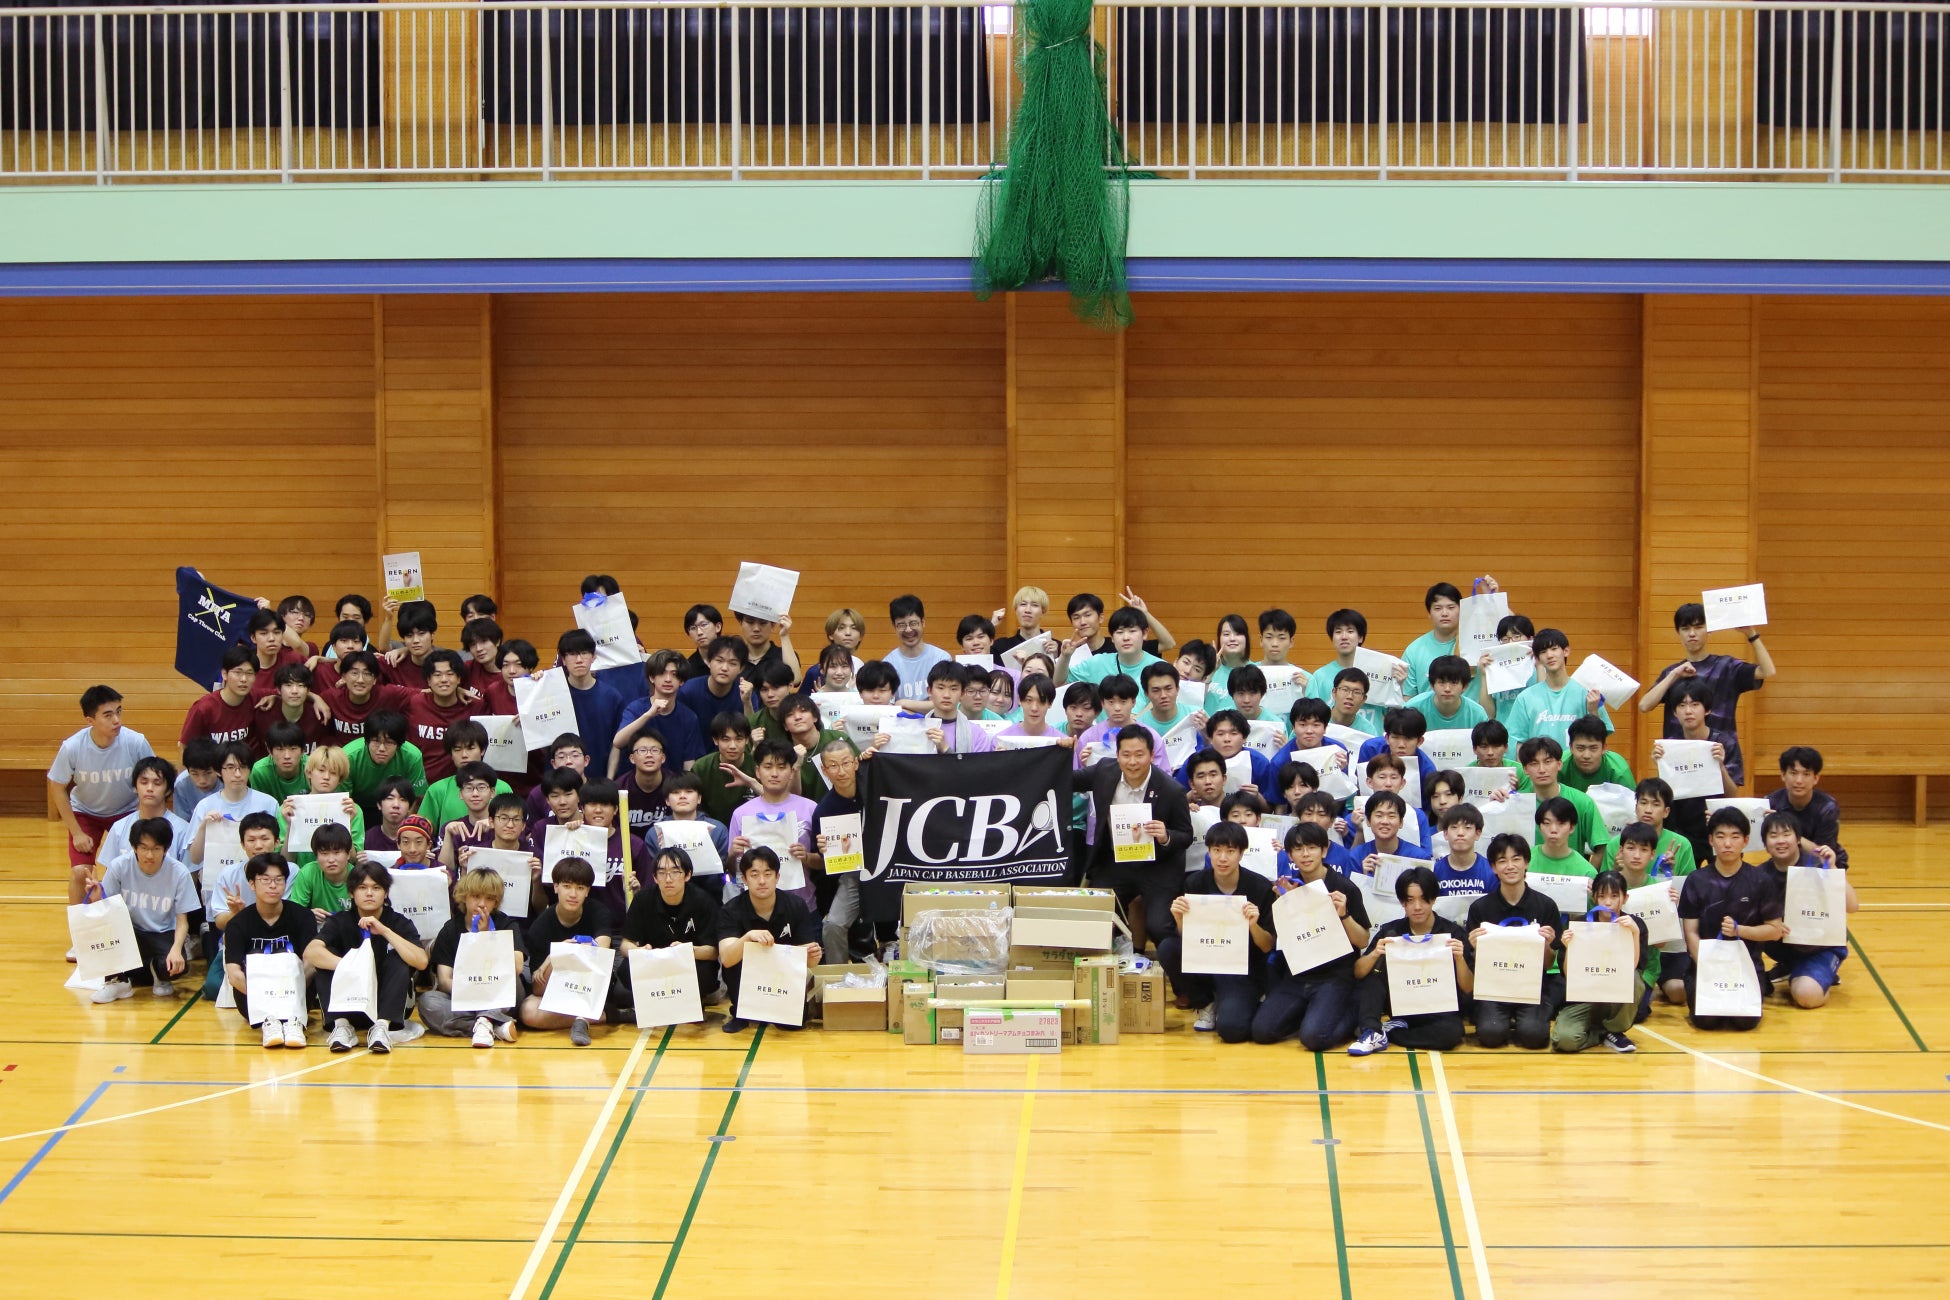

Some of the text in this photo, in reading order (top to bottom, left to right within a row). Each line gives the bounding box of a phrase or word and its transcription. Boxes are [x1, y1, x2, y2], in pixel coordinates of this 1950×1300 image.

[197, 594, 231, 624] MITA
[418, 724, 449, 741] WAS
[79, 767, 132, 784] TOKYO
[887, 861, 1067, 880] JAPAN CAP BASEBALL ASSOCIATION
[122, 889, 172, 913] TOKYO
